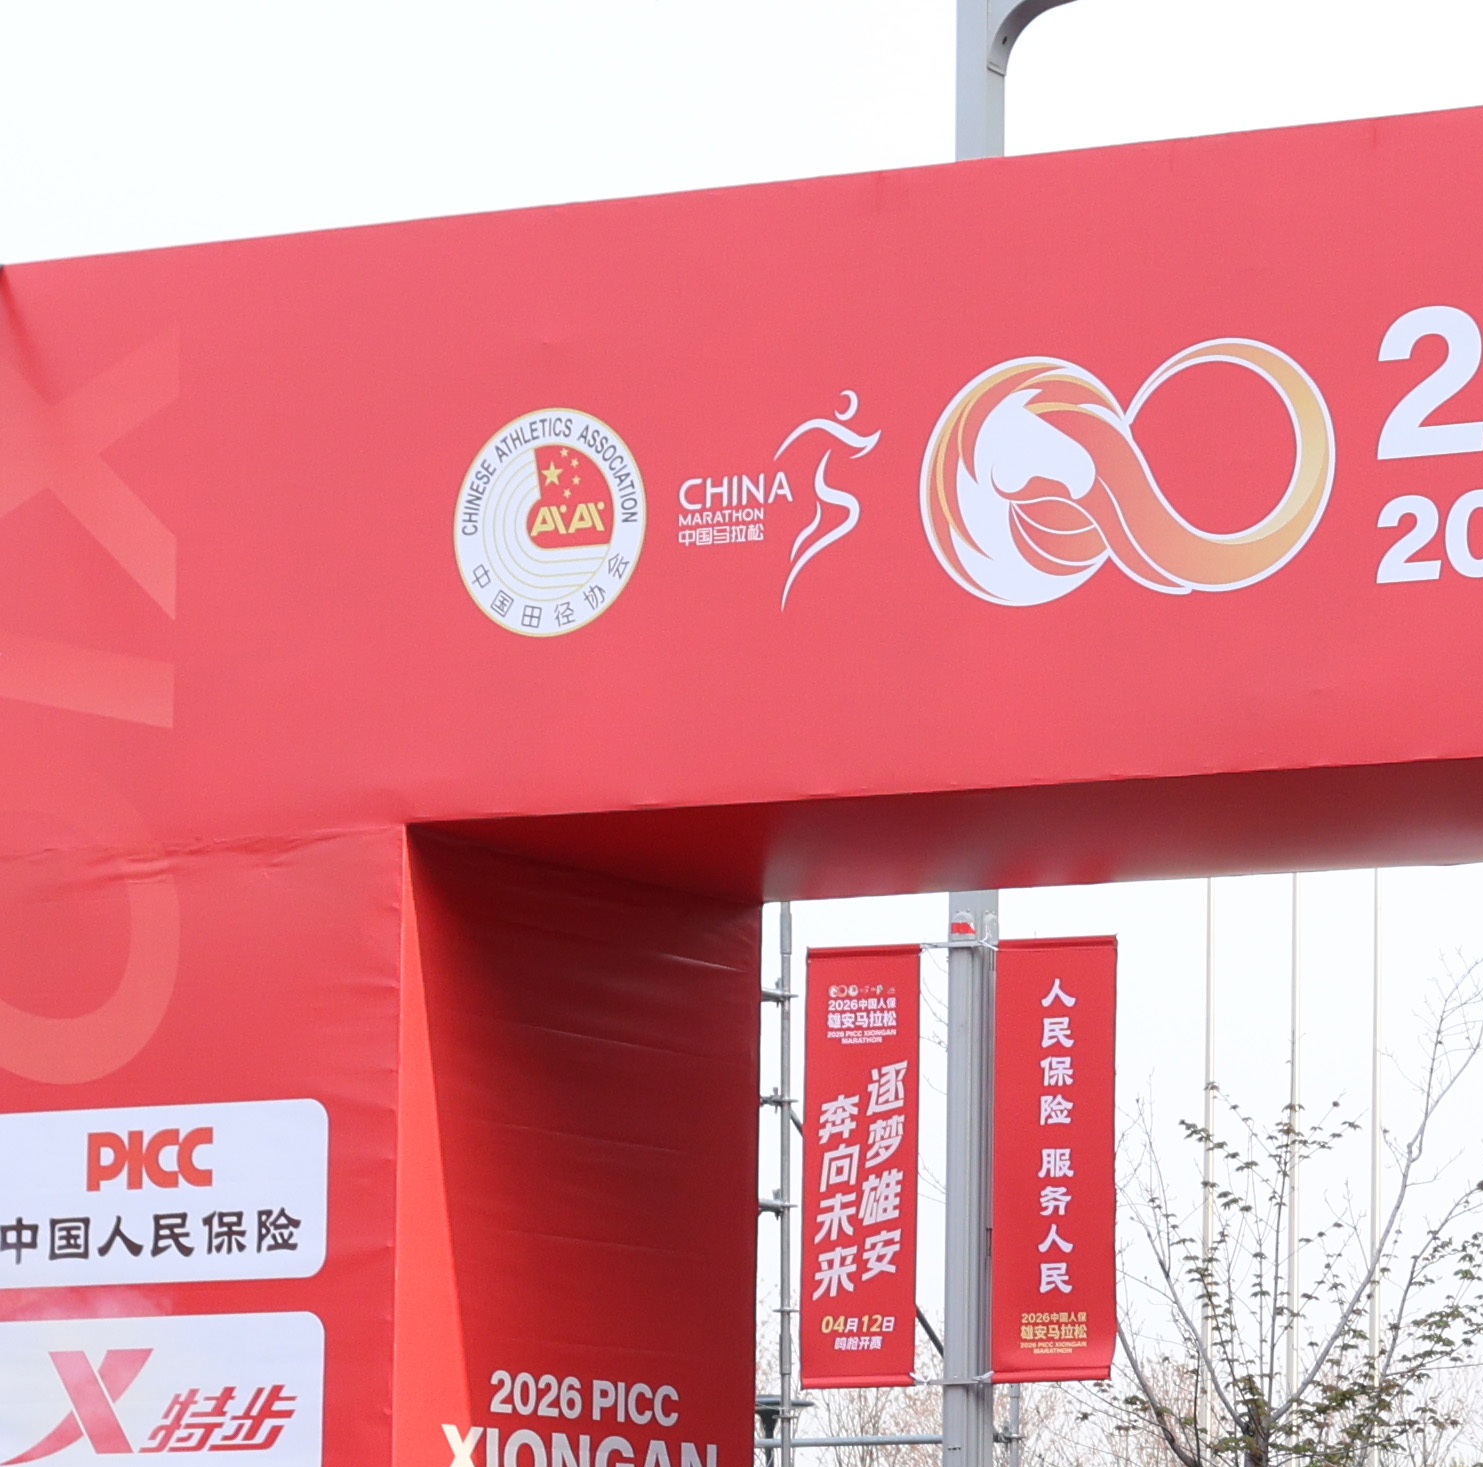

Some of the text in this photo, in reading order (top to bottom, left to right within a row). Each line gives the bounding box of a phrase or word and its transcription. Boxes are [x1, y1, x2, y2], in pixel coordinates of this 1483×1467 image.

[461, 416, 638, 536] CHINESE ATHLETICS ASSOCIATION
[678, 471, 794, 511] CHINA
[678, 507, 765, 527] MARATHON
[678, 522, 765, 547] 中国马拉松
[471, 552, 631, 629] 中国田径协会
[827, 997, 897, 1011] 2026中国人保
[85, 1126, 214, 1193] PICC
[1037, 977, 1077, 1294] 人民保险 服务人民
[812, 1093, 860, 1301] 奔向未来
[859, 1059, 909, 1282] 逐梦雄安
[0, 1208, 302, 1266] 中国人民保险
[820, 1313, 896, 1334] 04月12日
[137, 1383, 299, 1455] 特步
[488, 1369, 681, 1428] 2026 PICC
